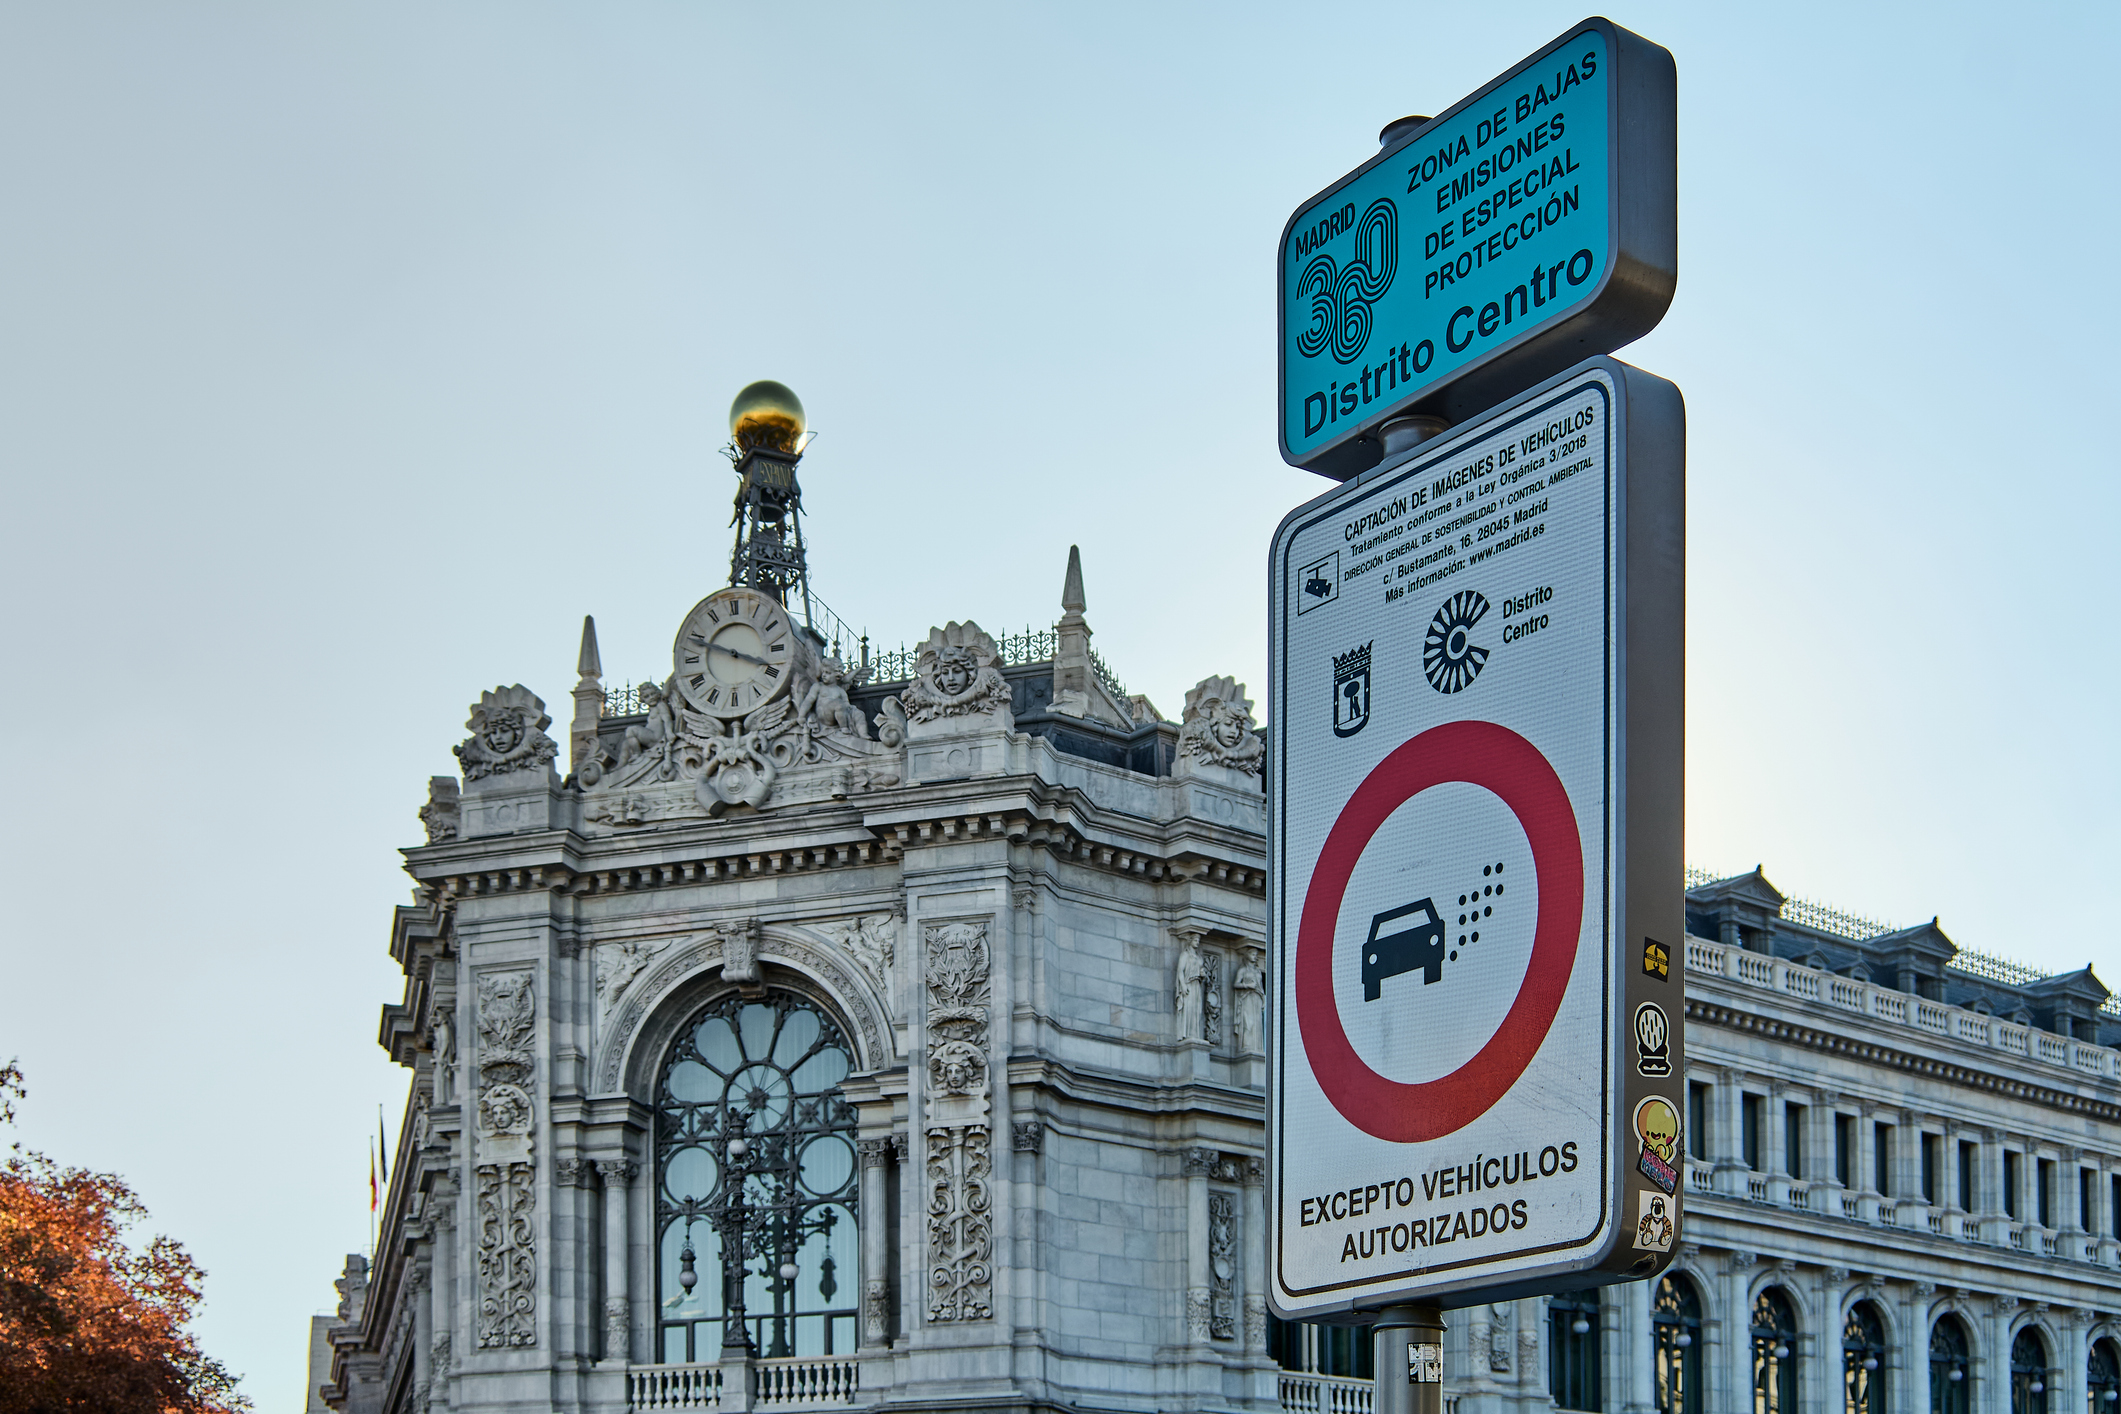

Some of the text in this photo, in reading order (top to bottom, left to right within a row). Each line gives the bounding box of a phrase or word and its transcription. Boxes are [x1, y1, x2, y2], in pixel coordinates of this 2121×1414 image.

[1407, 51, 1596, 194] ZONA DE BAJAS
[1436, 113, 1565, 212] EMISIONES
[1295, 202, 1355, 262] MADRID
[1425, 148, 1580, 260] DE ESPECIAL
[1425, 184, 1579, 299] PROTECCIÓN
[1296, 197, 1398, 365] 360
[1305, 249, 1593, 438] Distrito Centro
[1344, 457, 1593, 581] DIRECCIÓN GENERAL DE SOSTENIBILIDAD Y CONTROL AMBIENTAL
[1345, 406, 1593, 541] CAPTACIÓN DE IMÁGENES DE VEHÍCULOS
[1351, 434, 1586, 557] Tratamiento conforme a la Ley Orgánica 3/2018
[1383, 567, 1394, 585] c/
[1398, 543, 1456, 578] Bustamante,
[1477, 515, 1509, 542] 28045
[1513, 497, 1548, 525] Madrid
[1385, 523, 1545, 603] Más información: www.madrid.es
[1503, 586, 1553, 619] Distrito
[1503, 613, 1549, 644] Centro
[1300, 1141, 1578, 1227] EXCEPTO VEHÍCULOS
[1341, 1199, 1527, 1263] AUTORIZADOS
